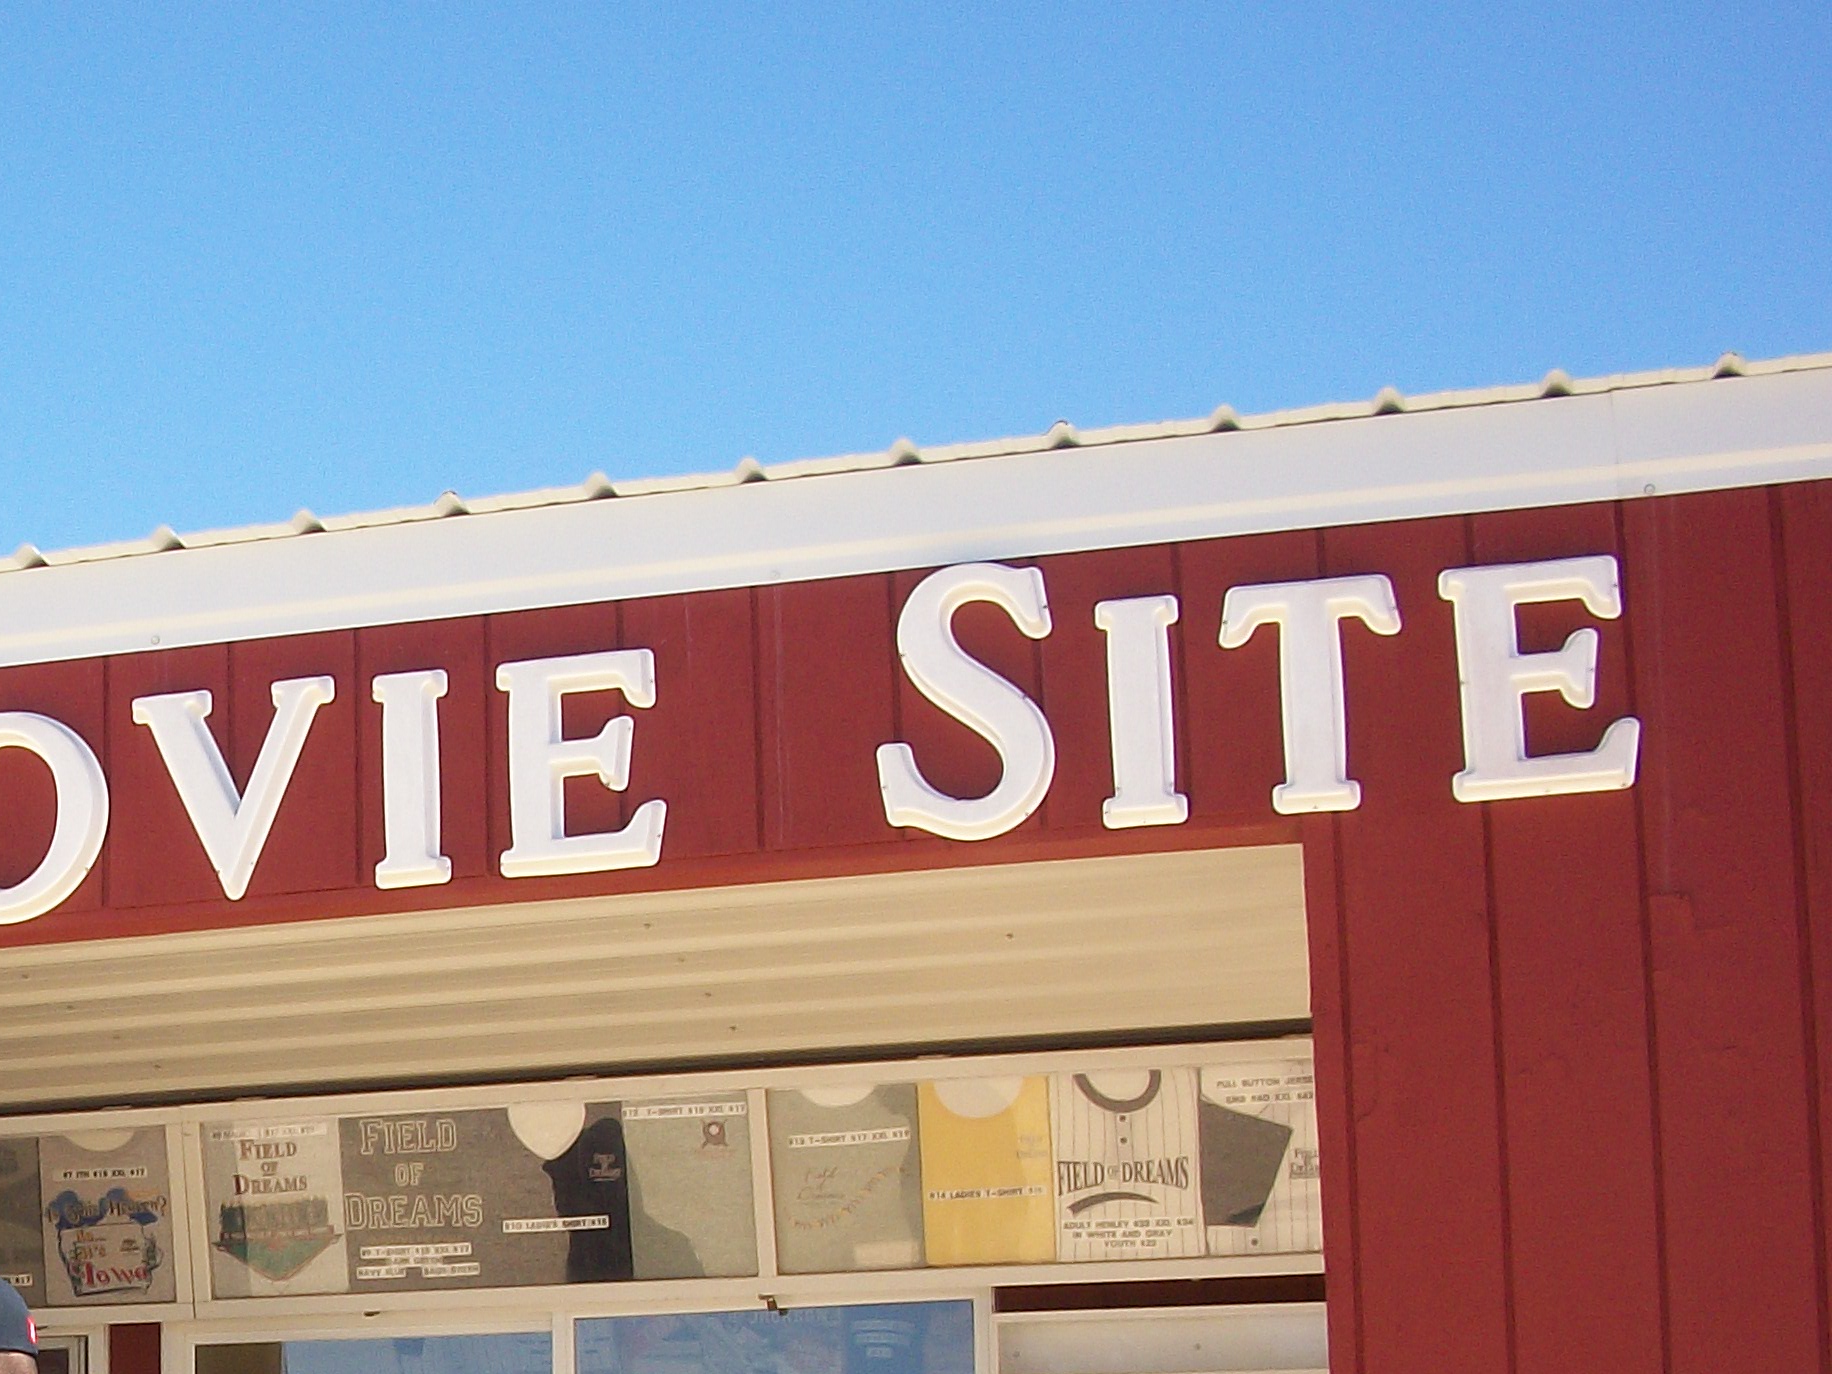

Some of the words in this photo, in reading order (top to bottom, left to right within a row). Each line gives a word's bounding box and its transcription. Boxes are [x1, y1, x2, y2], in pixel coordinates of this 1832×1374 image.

[876, 555, 1641, 841] SITE
[239, 1138, 297, 1161] FIELD
[360, 1118, 457, 1155] FIELD
[233, 1174, 308, 1196] DREAMS
[394, 1163, 425, 1187] OF
[1057, 1159, 1105, 1197] FIELD
[1121, 1156, 1189, 1192] DREAMS
[344, 1192, 484, 1231] DREAMS
